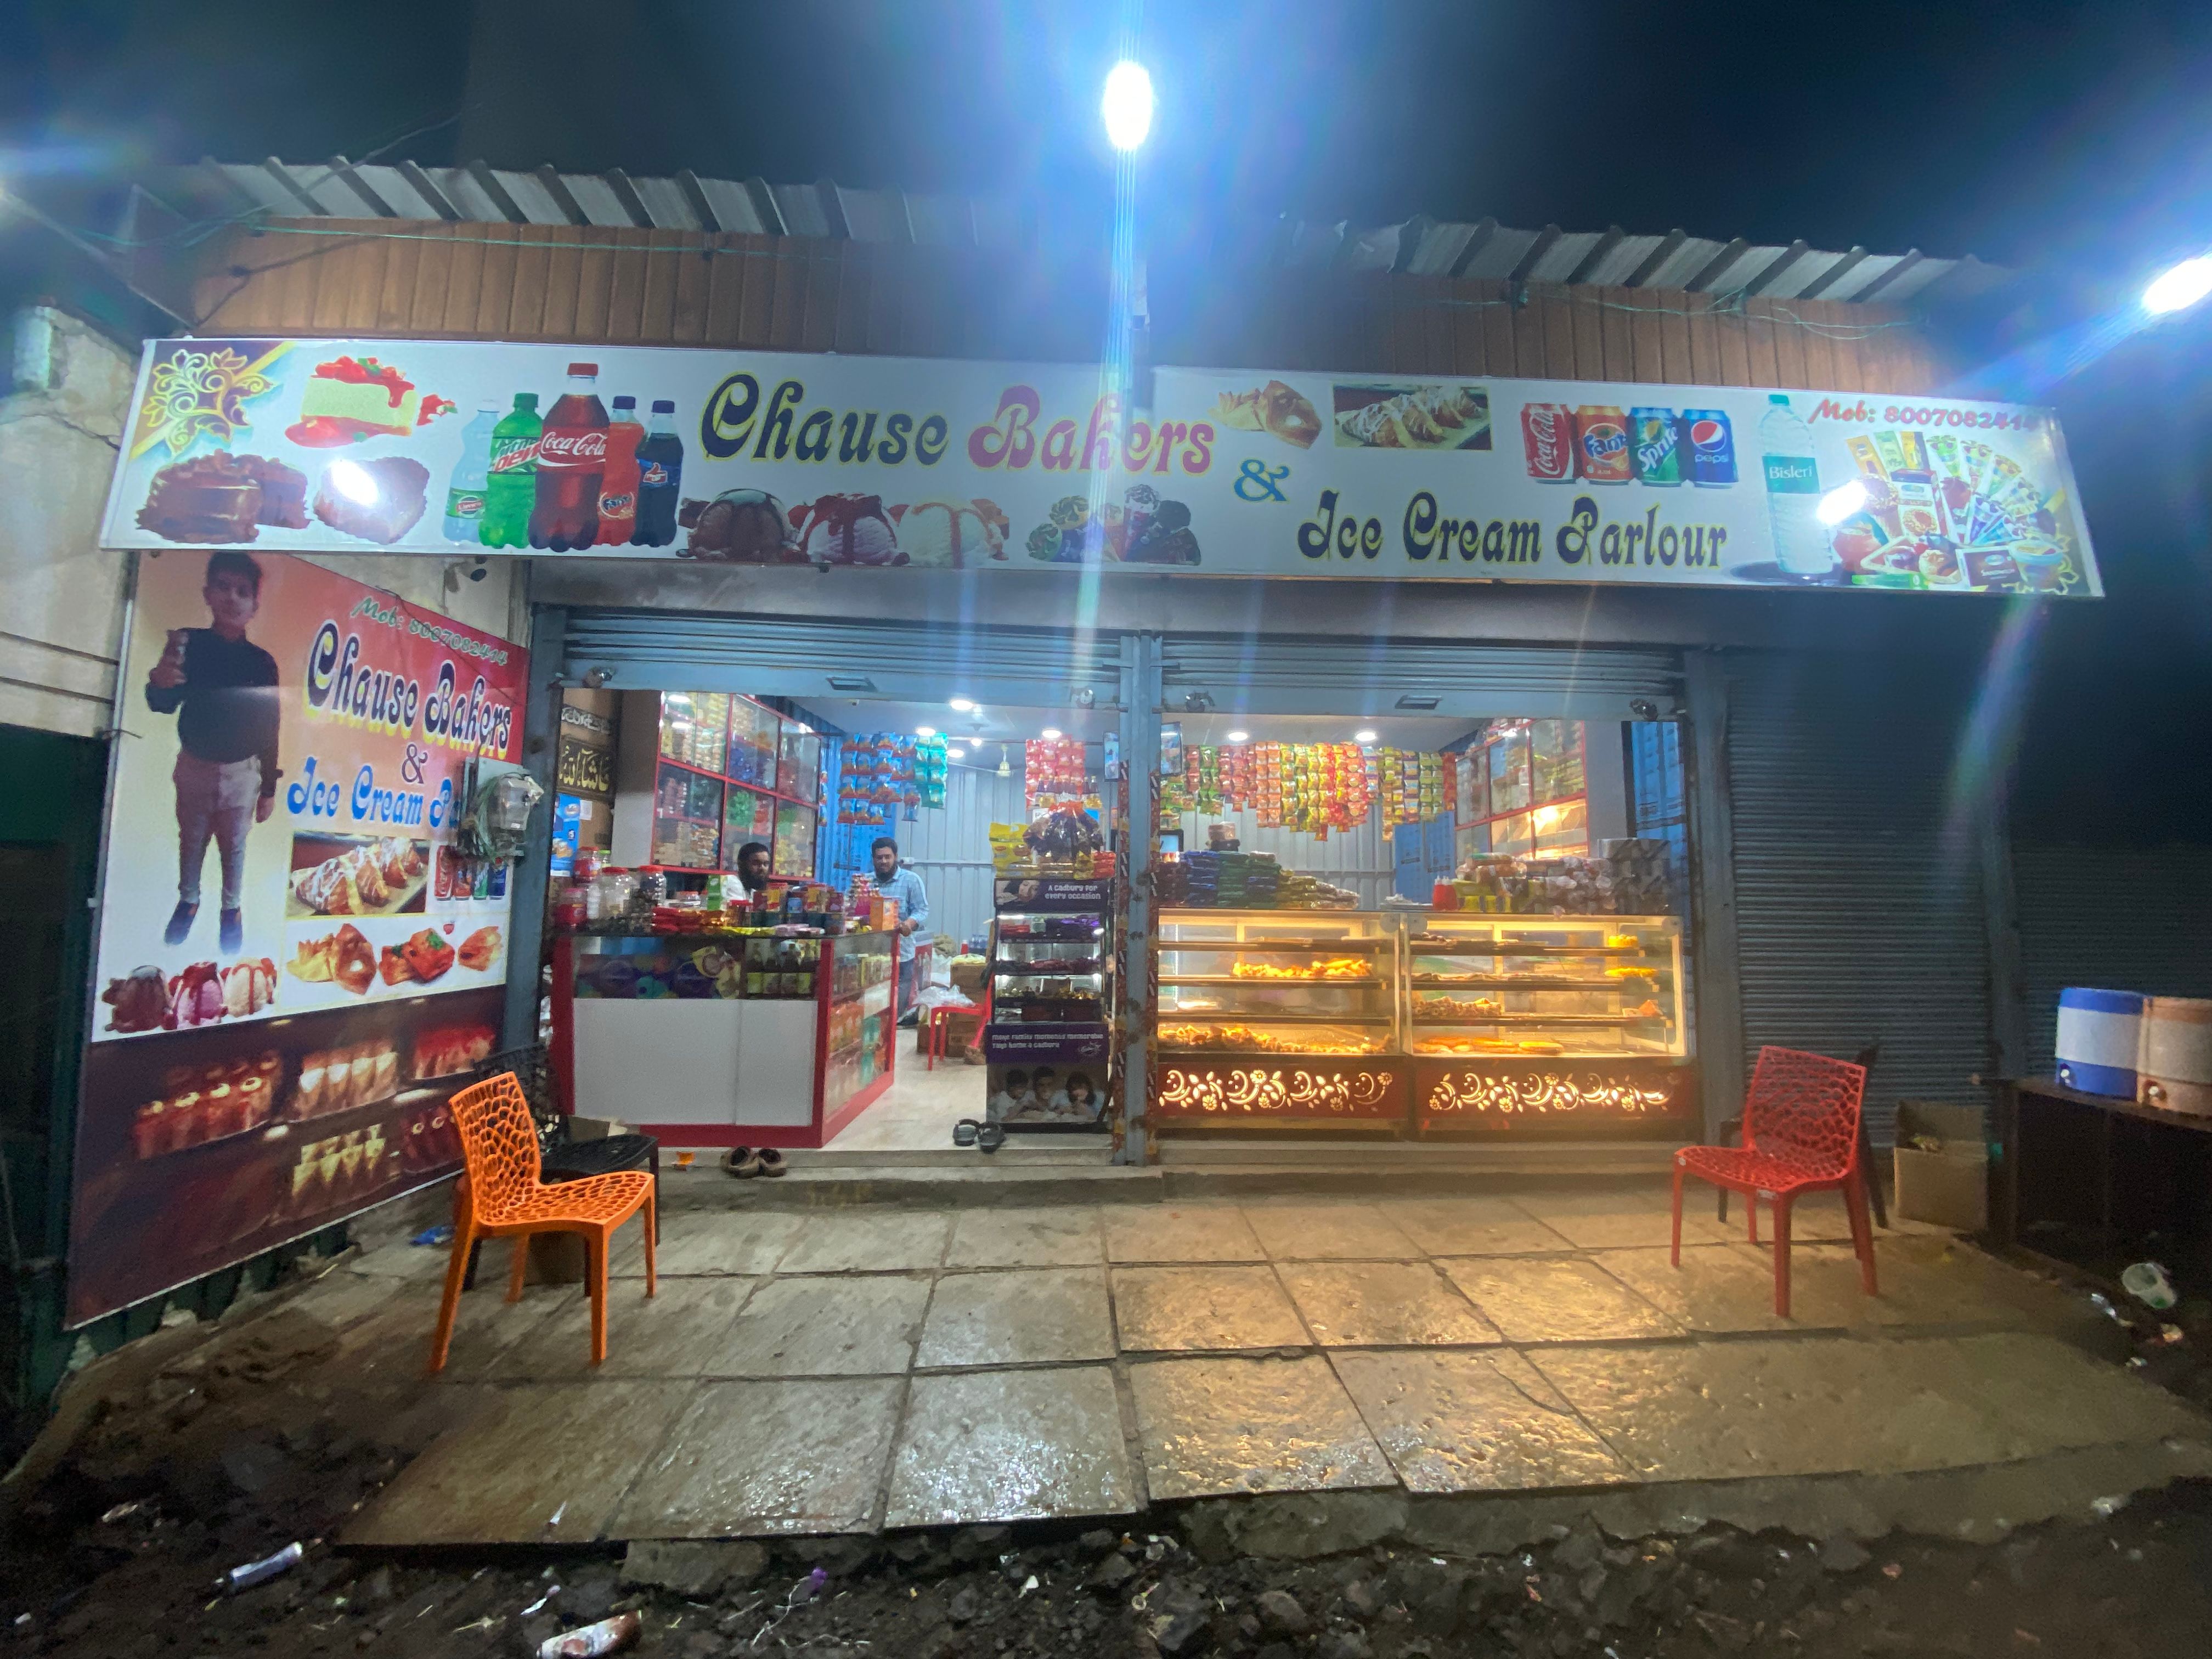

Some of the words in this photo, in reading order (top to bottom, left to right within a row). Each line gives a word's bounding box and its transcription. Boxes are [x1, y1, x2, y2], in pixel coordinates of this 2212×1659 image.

[701, 371, 949, 465] Chause
[967, 384, 1216, 475] Bakers
[1808, 398, 1876, 424] Mob:
[1234, 459, 1291, 503] &
[1769, 465, 1812, 479] Bisleri
[1298, 488, 1383, 566] Ice
[1403, 490, 1541, 566] Cream
[1556, 494, 1728, 569] Parlour
[351, 596, 403, 630] Mob:
[306, 619, 419, 731] Chause
[424, 660, 511, 753] Bakers
[402, 743, 428, 784] &
[287, 756, 340, 817] Ice
[352, 765, 424, 825] Cream
